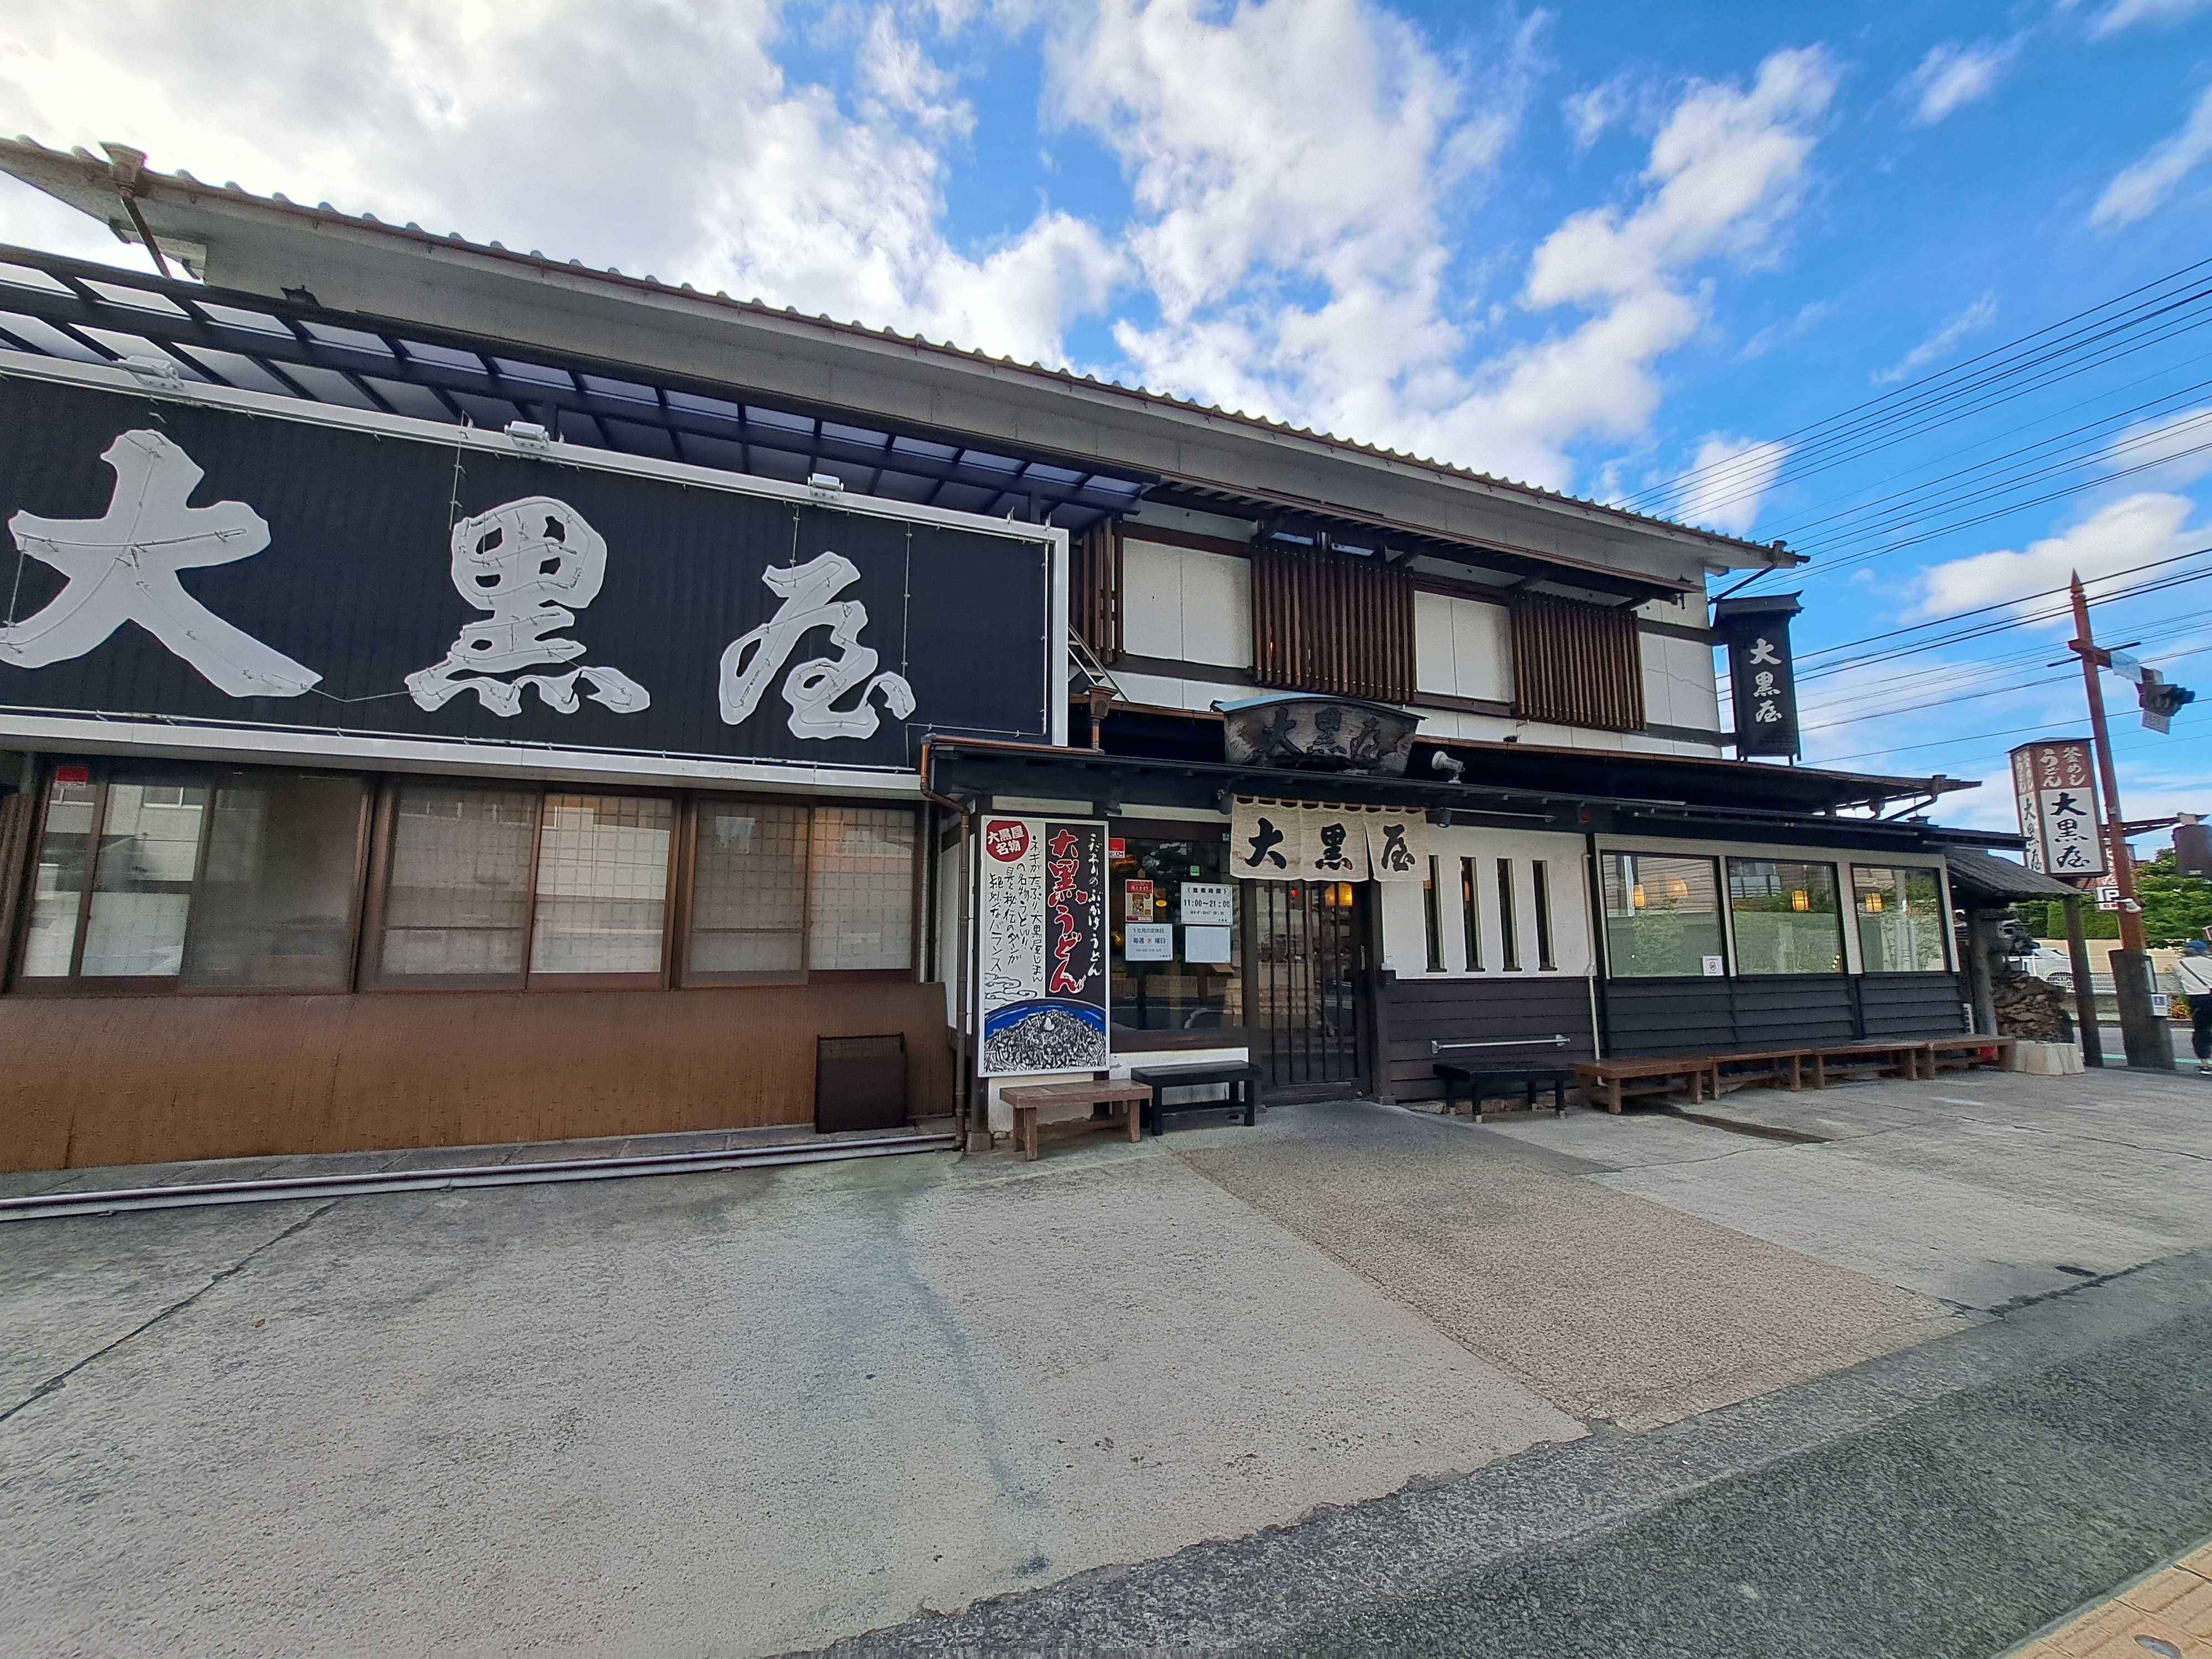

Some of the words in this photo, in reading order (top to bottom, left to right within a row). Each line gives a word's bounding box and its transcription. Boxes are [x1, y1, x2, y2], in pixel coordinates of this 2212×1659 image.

[0, 430, 915, 739] 大黒屋
[1750, 638, 1782, 723] 大黒屋
[2040, 748, 2062, 787] うどん
[2062, 747, 2085, 786] 釜めし
[987, 825, 1025, 844] 大黒屋
[995, 839, 1021, 855] 名物
[1245, 817, 1415, 872] 大黒屋
[2051, 792, 2091, 868] 大黒屋
[989, 873, 1004, 972] 絶妙なバランス
[1047, 829, 1088, 993] 大黒うどん
